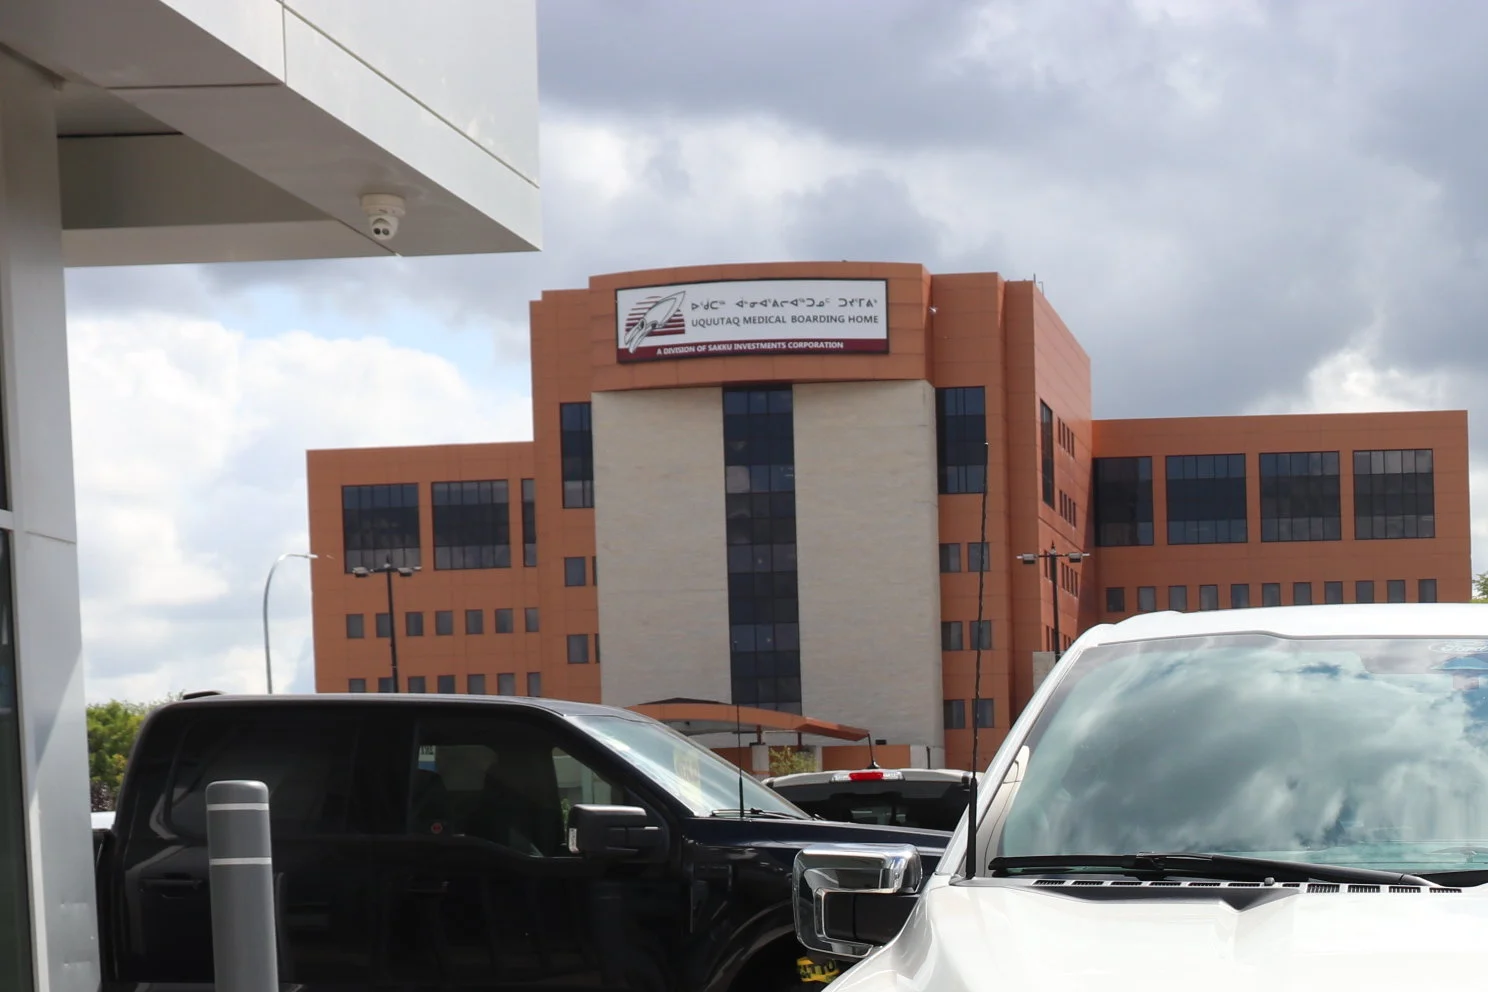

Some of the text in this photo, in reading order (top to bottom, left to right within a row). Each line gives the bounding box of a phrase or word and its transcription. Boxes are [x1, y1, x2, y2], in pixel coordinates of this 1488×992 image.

[691, 314, 879, 329] UQUUTAQ MEDICAL BOARDING HOME
[656, 341, 844, 356] A DIVISION OF SAKKU INVESTMENTS CORPORATION
